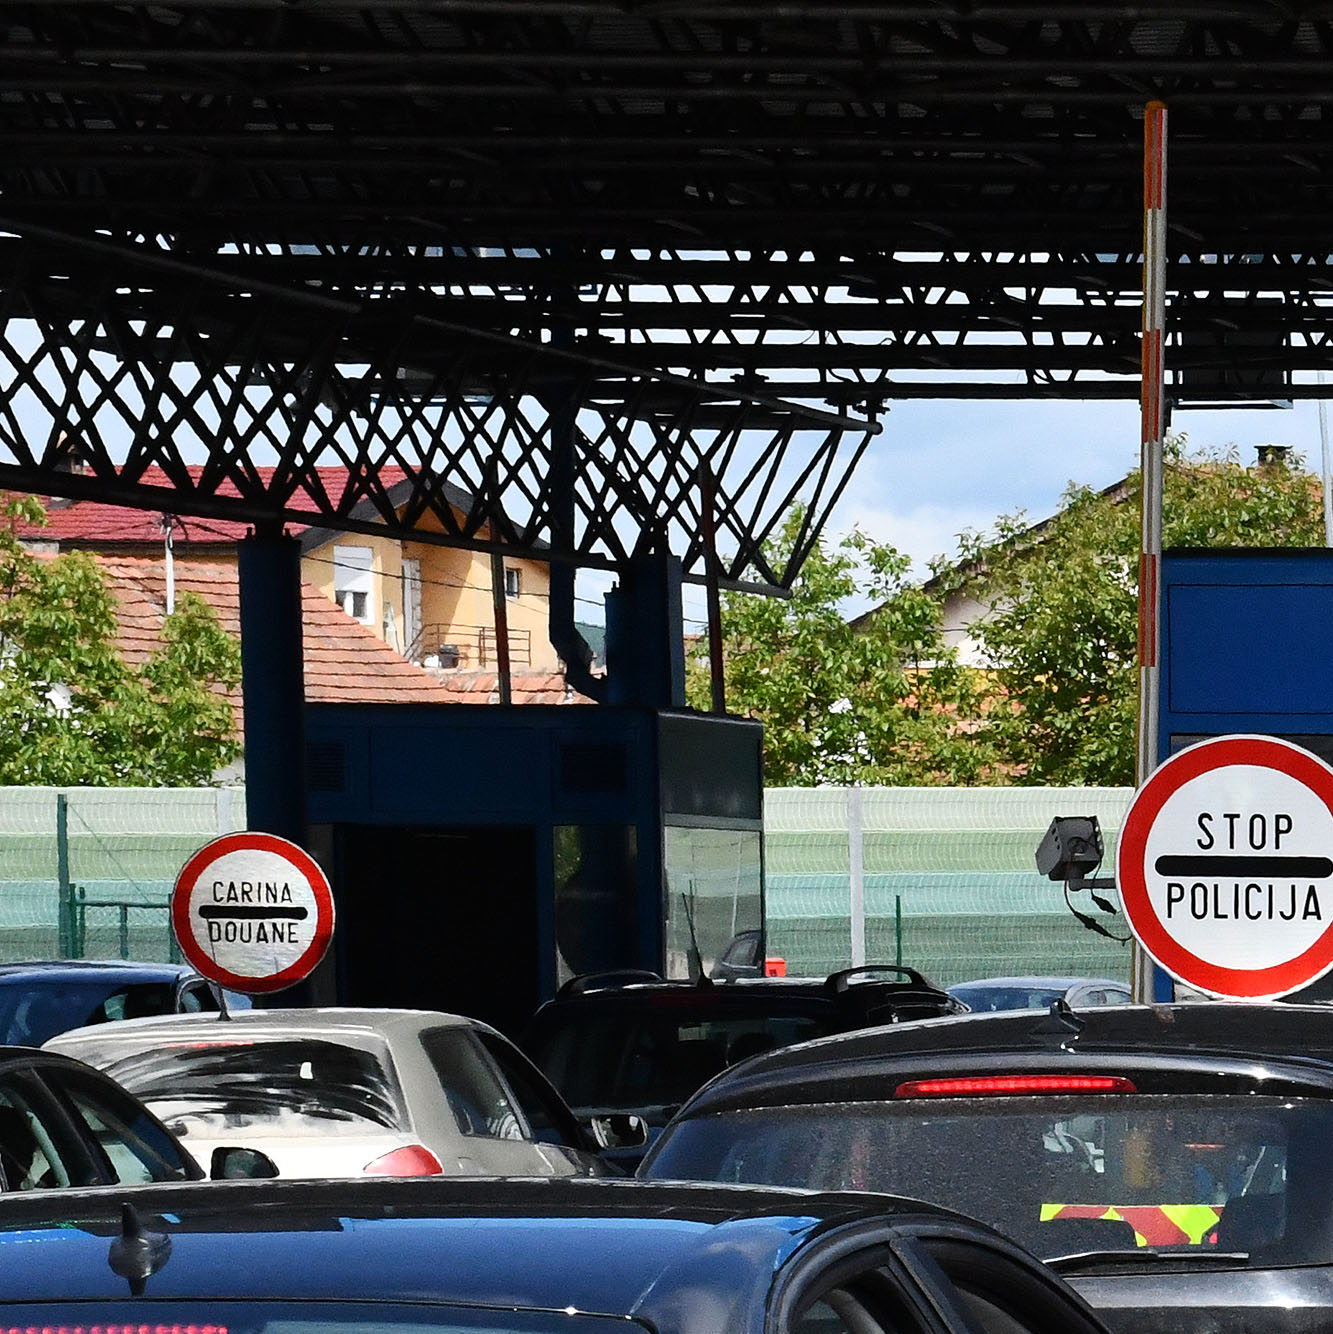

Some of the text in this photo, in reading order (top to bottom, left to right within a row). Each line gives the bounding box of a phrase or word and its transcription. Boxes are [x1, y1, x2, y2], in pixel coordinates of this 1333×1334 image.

[1196, 812, 1293, 850] STOP
[212, 880, 293, 904] CARINA
[1166, 882, 1323, 921] POLICIJA
[208, 920, 299, 943] DOUANE
